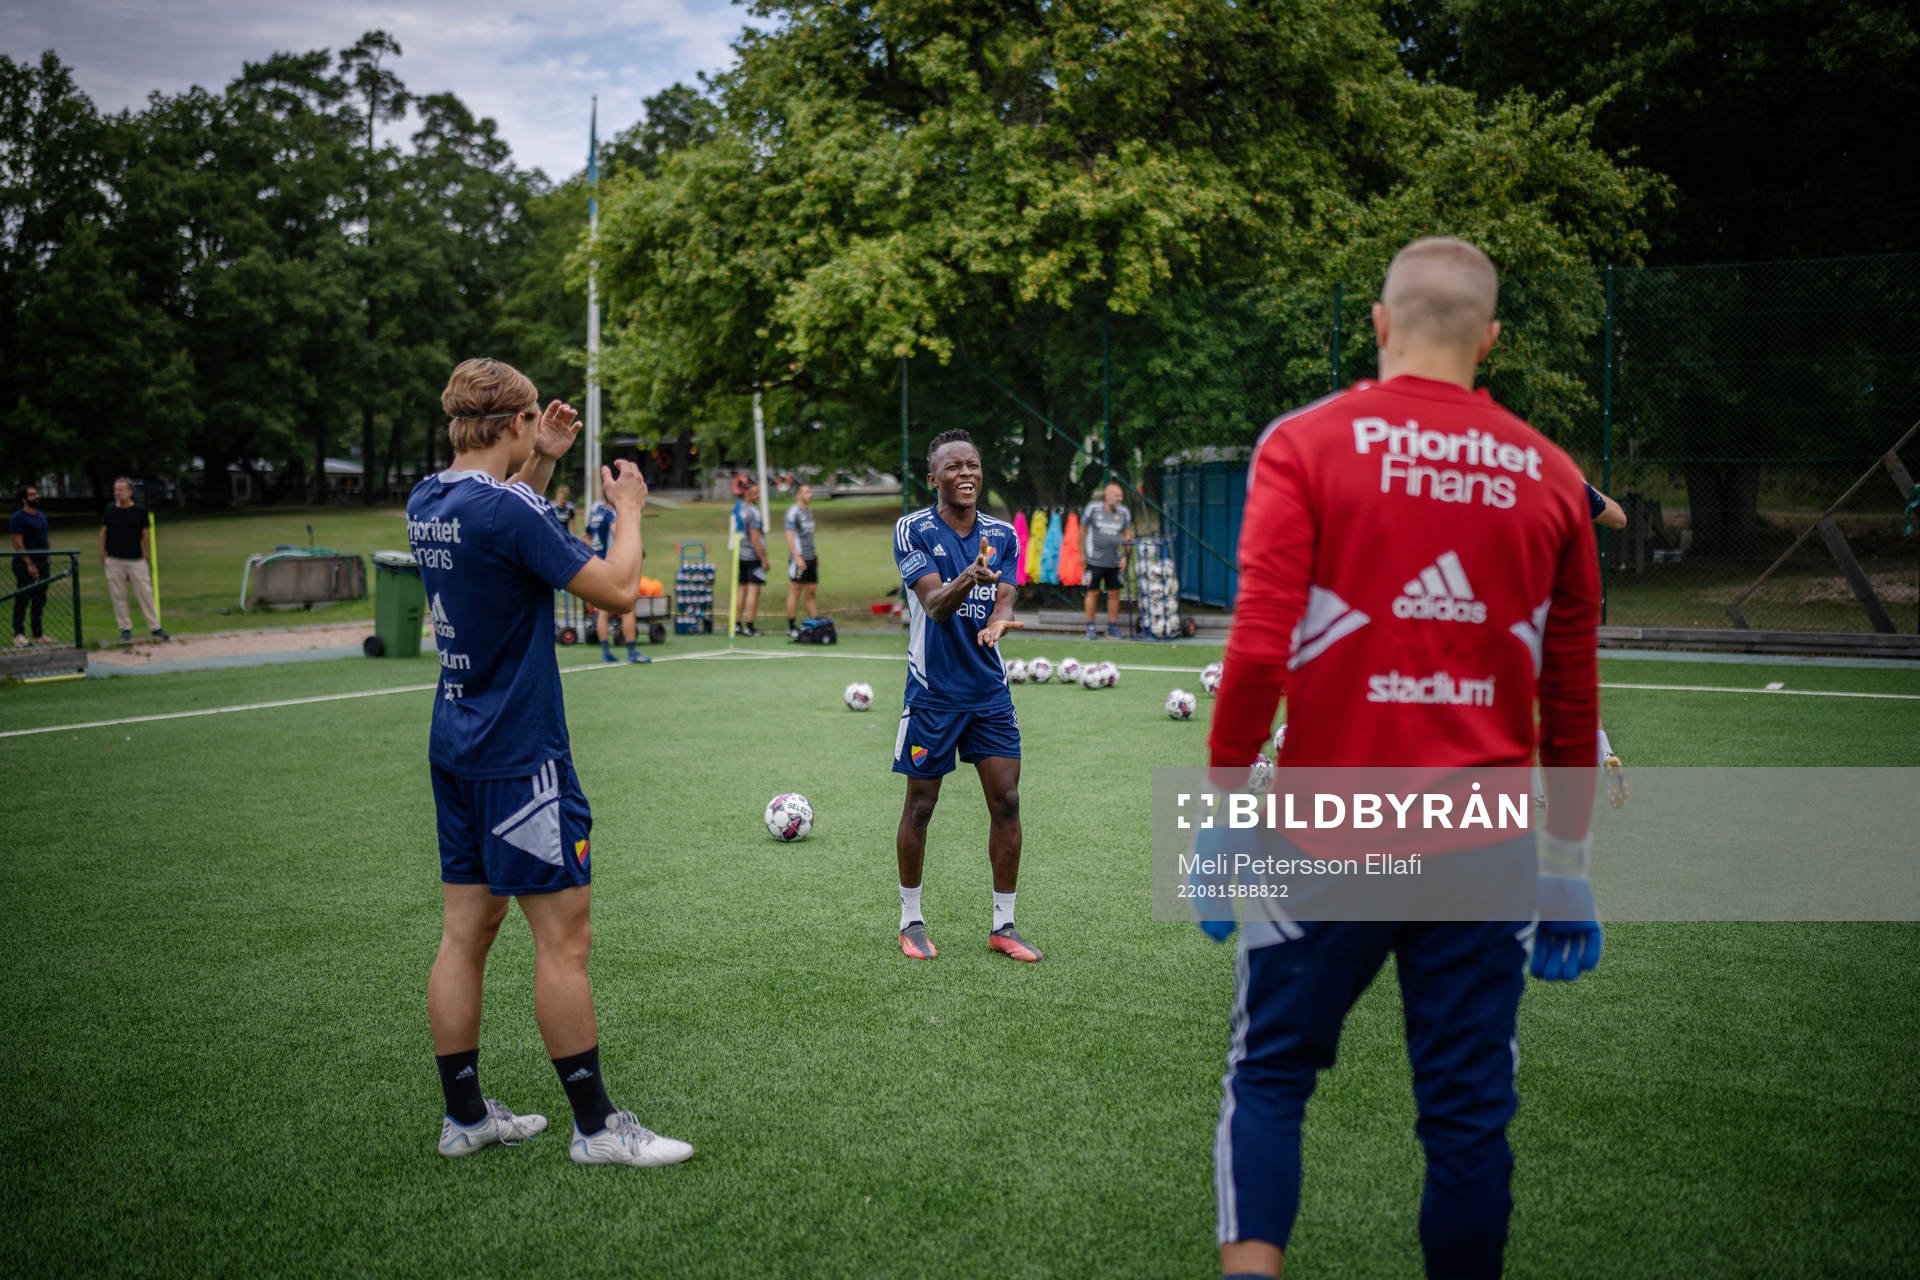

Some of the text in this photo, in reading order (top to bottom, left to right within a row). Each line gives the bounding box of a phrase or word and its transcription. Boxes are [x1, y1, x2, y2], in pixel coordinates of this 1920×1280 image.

[1352, 417, 1543, 481] Prioritet
[1380, 452, 1517, 509] Finans
[407, 513, 461, 544] rioritet
[1392, 595, 1488, 624] adidas
[1366, 669, 1496, 707] stadium
